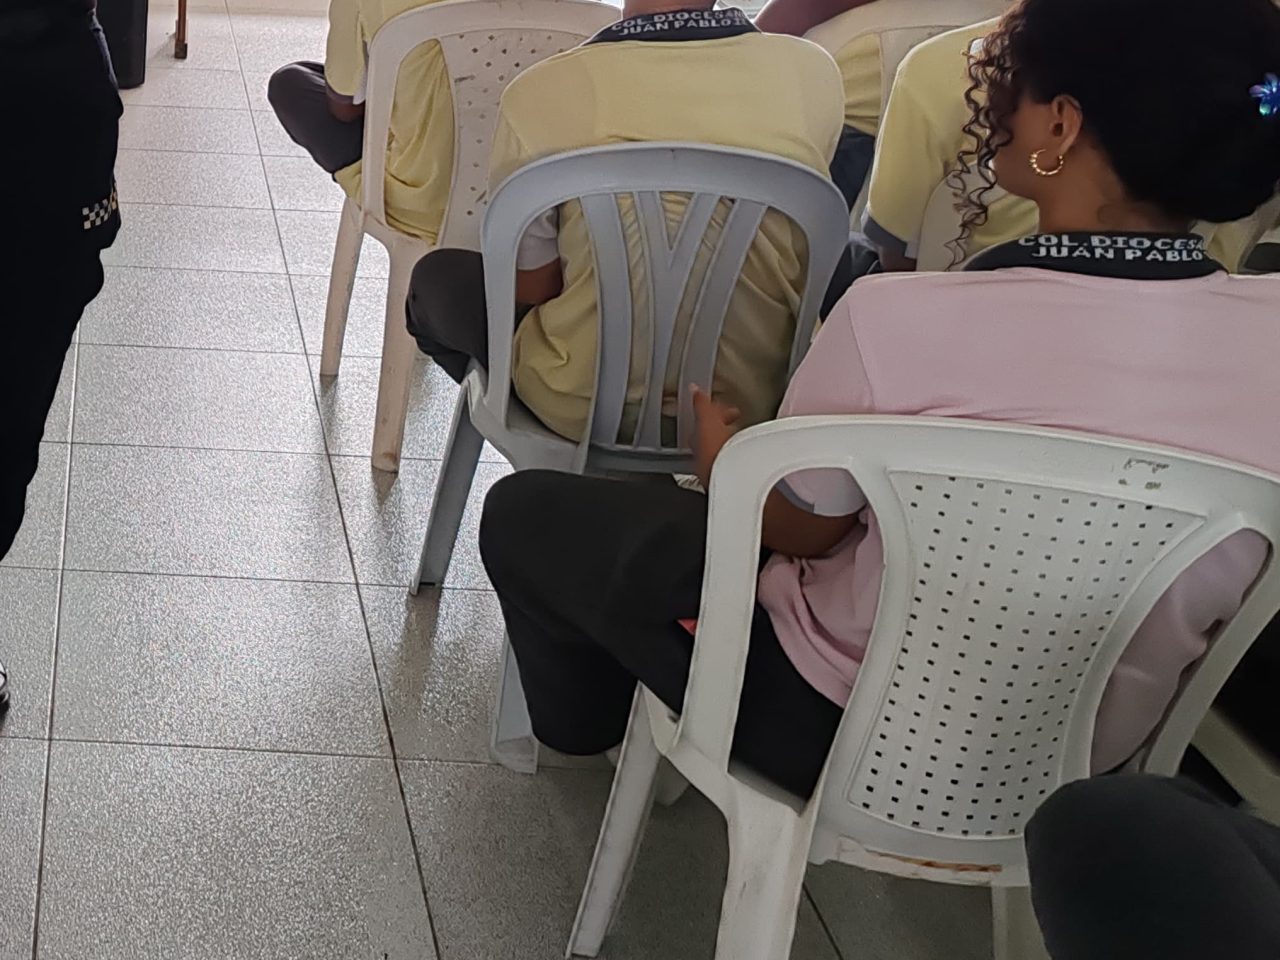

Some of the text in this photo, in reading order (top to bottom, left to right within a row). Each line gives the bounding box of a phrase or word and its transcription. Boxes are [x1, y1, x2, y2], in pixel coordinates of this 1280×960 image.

[619, 23, 669, 35] JUAN
[674, 18, 731, 29] PABLO
[1032, 246, 1203, 262] JUAN PABLO
